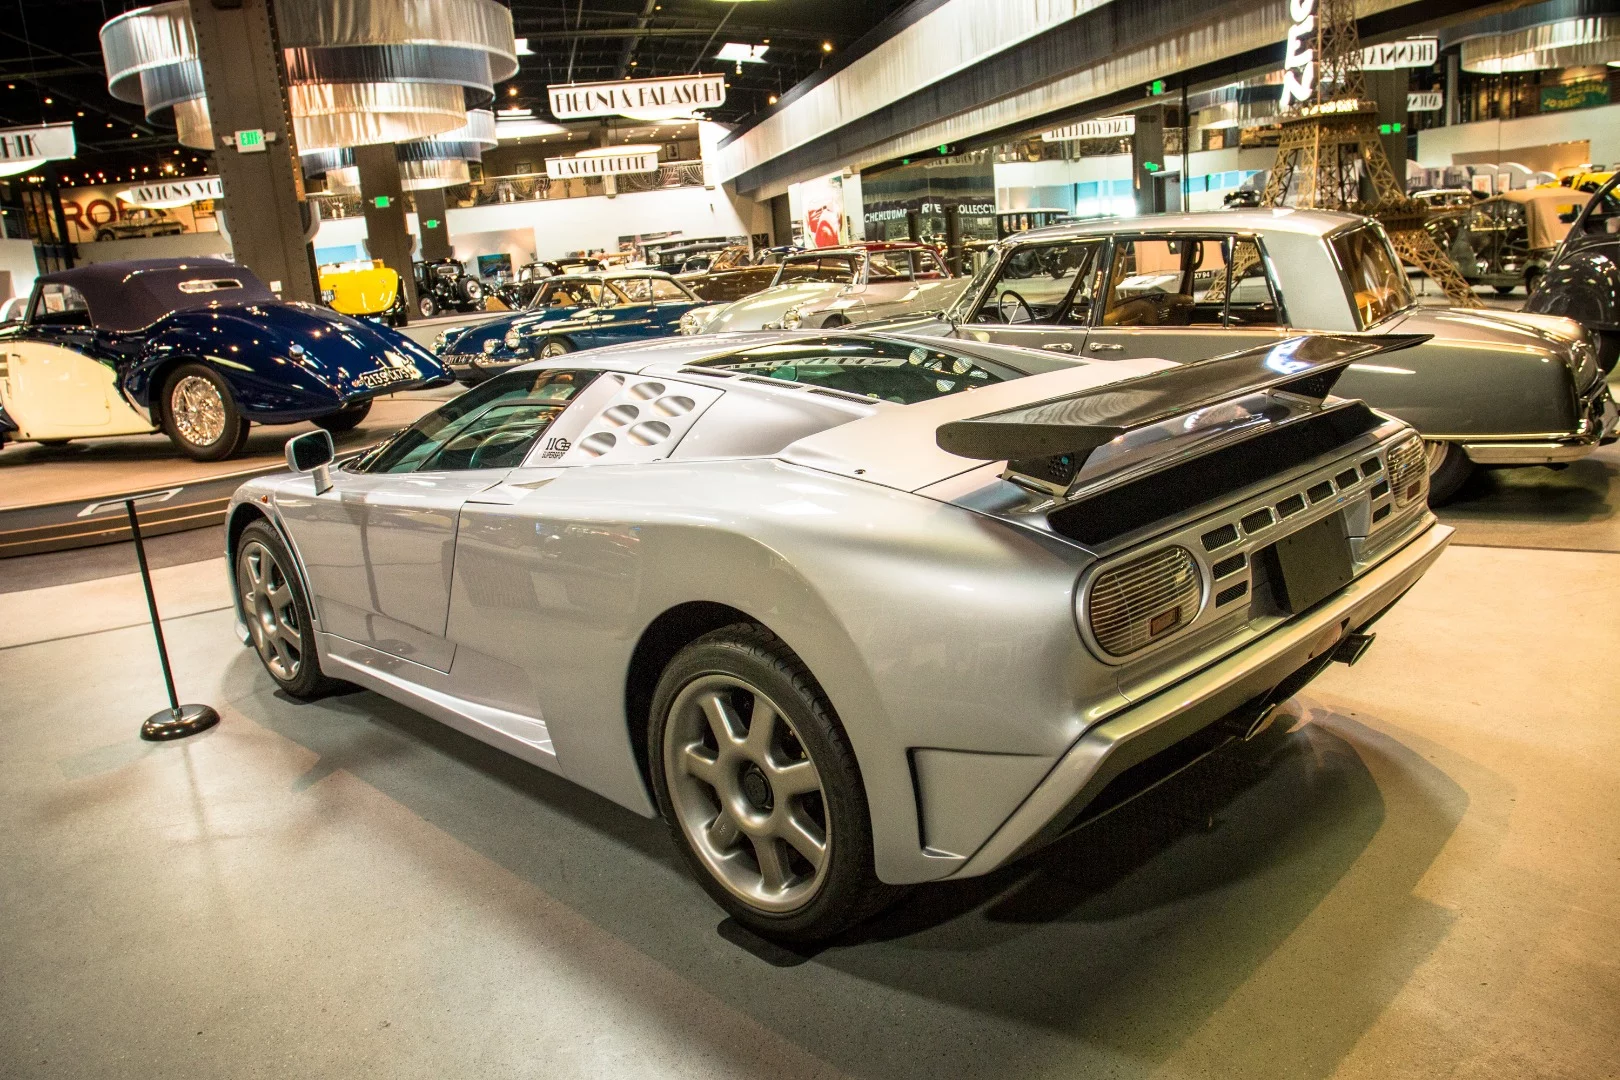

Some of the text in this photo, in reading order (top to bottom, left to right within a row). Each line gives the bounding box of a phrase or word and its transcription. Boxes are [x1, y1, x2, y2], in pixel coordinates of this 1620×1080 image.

[555, 82, 722, 113] FIGONI & FALASCHI
[241, 131, 259, 146] EXIT
[137, 183, 191, 202] AVIONS
